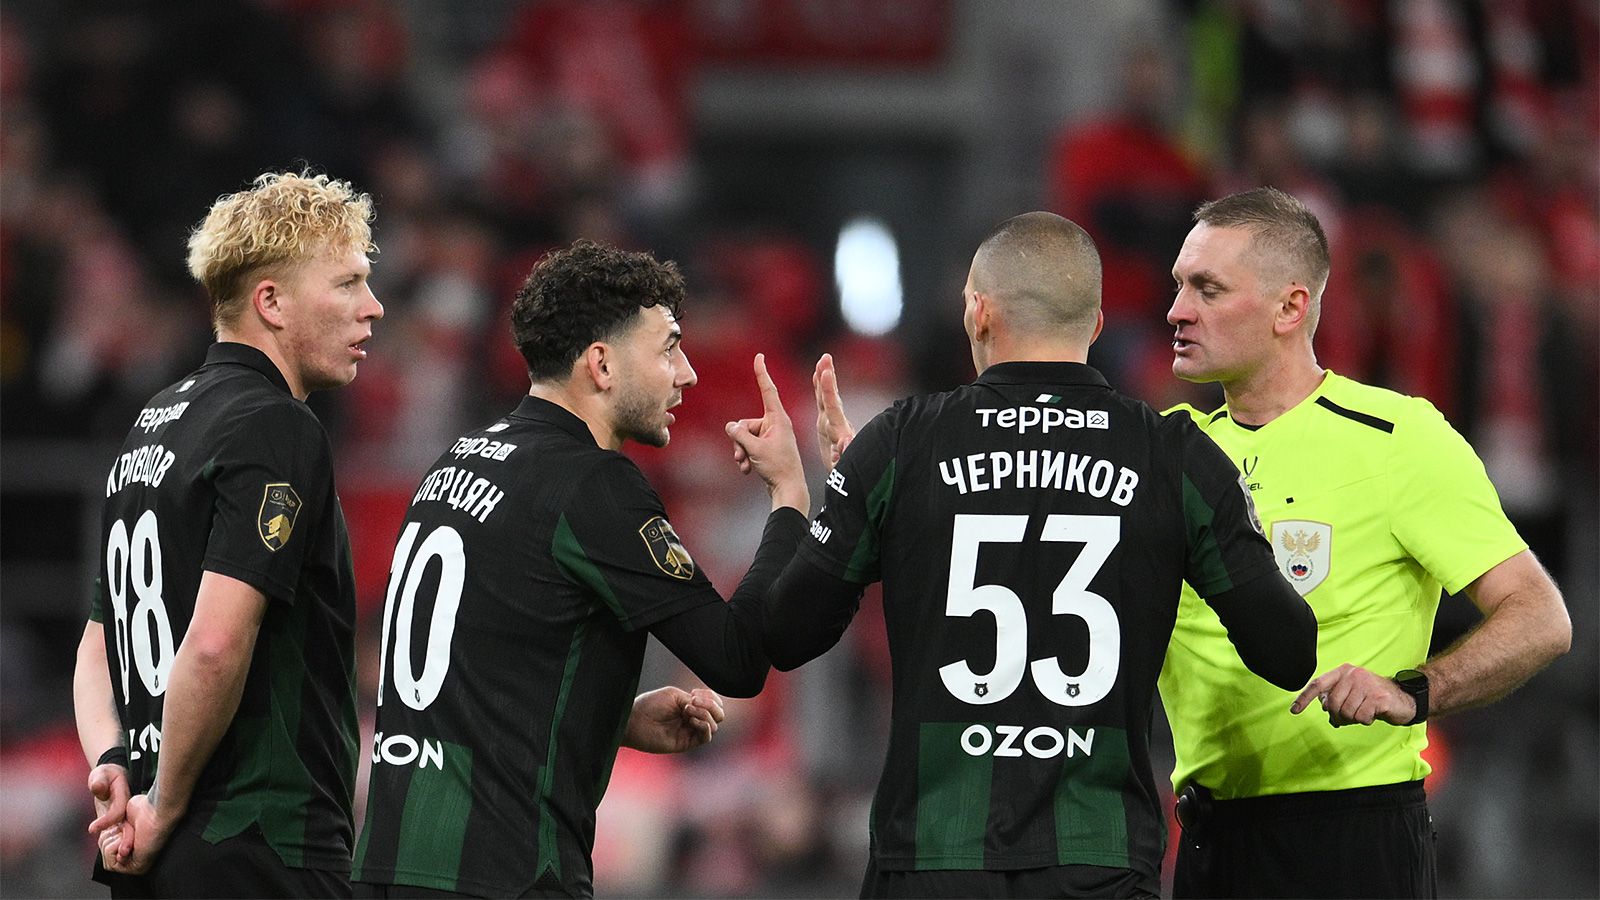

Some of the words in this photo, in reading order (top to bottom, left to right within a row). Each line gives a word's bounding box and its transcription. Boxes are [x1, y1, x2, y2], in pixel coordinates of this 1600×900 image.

[938, 450, 1139, 507] ЧЕРНИКОВ
[974, 407, 1085, 434] терра
[106, 509, 175, 706] 88
[377, 522, 466, 711] 10
[938, 513, 1121, 707] 53
[960, 724, 1095, 759] OZON
